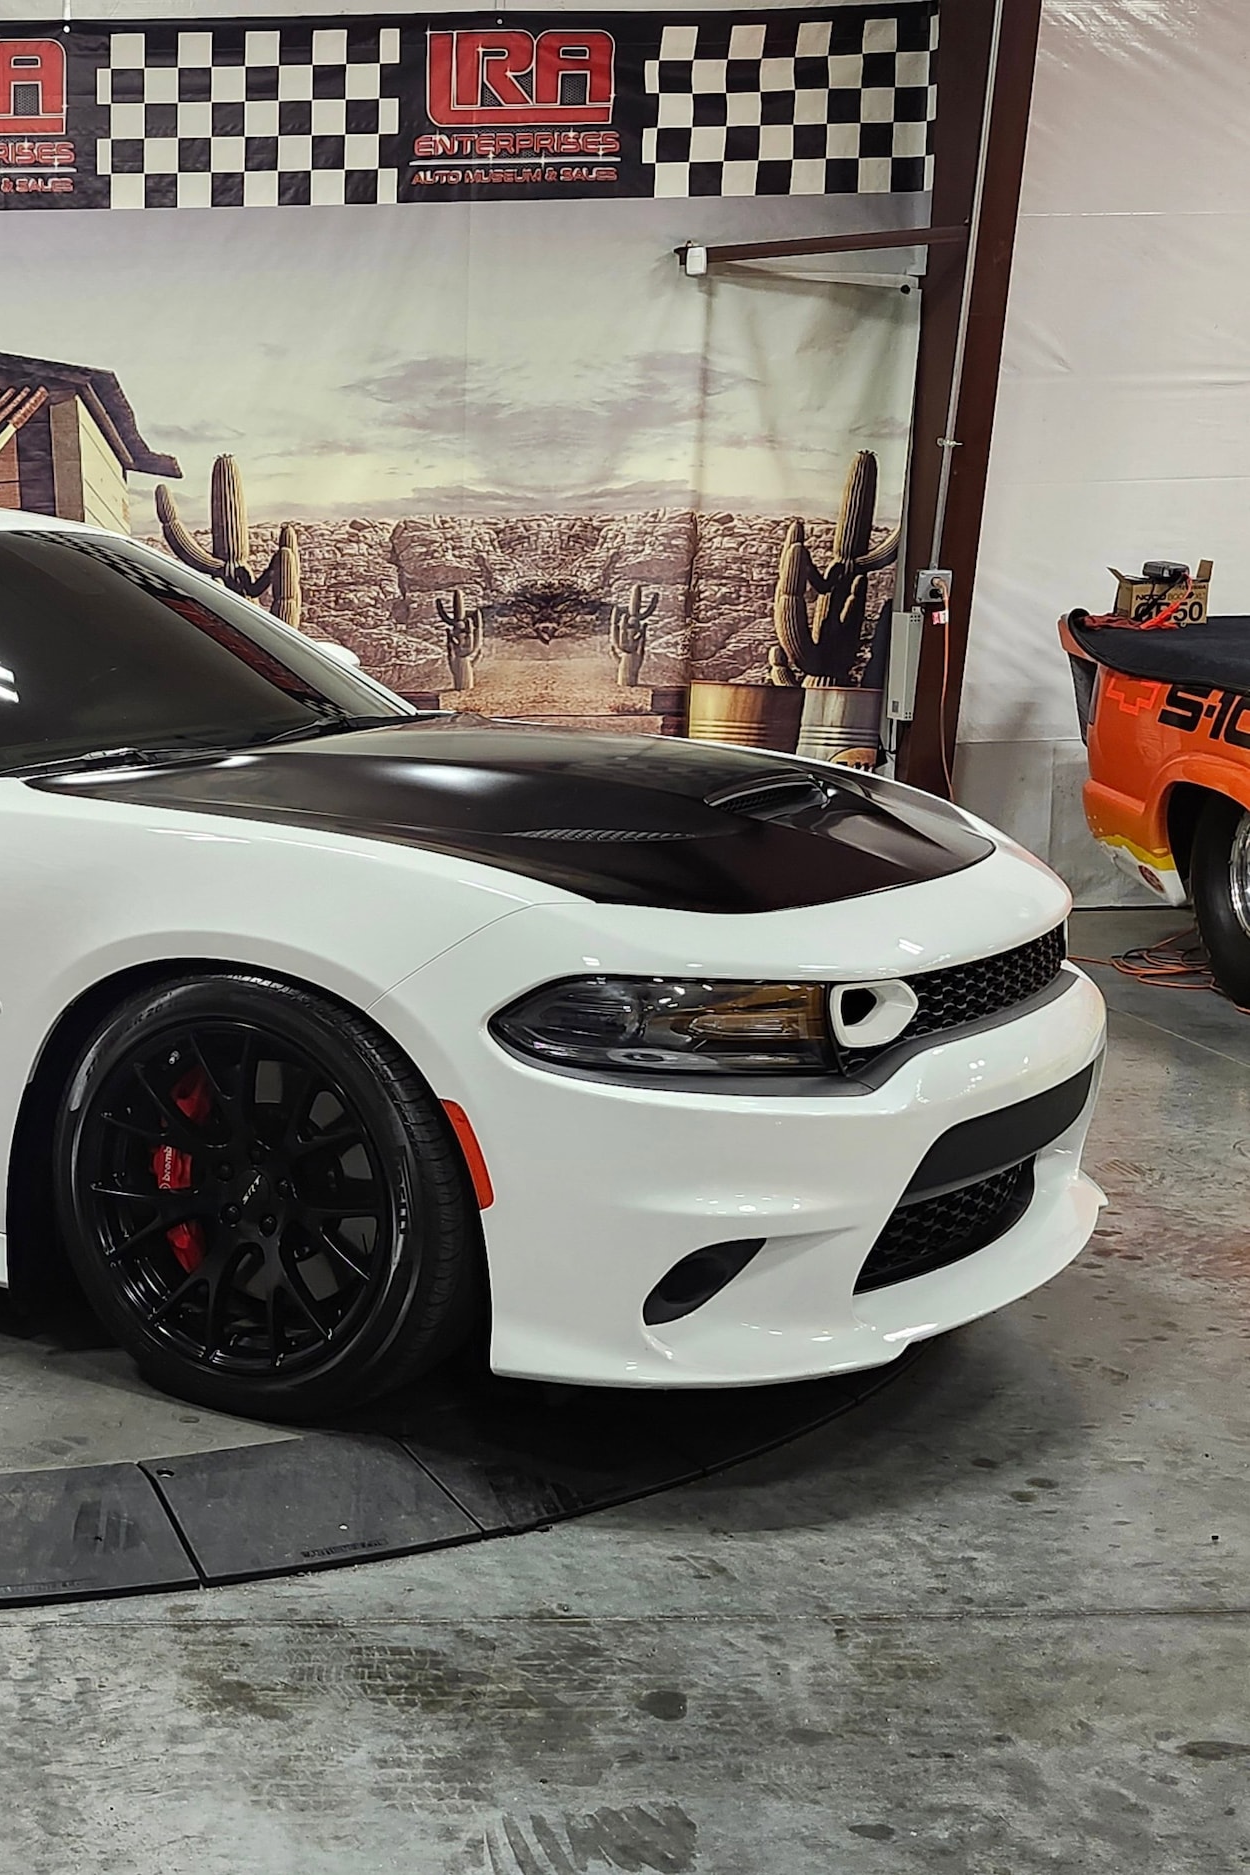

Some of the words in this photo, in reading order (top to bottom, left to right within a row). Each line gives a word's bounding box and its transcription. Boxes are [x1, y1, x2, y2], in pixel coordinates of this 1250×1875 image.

[426, 29, 615, 127] LRA
[414, 131, 620, 156] ENTERPRISES
[1, 179, 14, 193] &
[15, 177, 74, 193] SALES
[411, 169, 462, 185] AUTO
[464, 169, 542, 184] MUSEUM
[545, 168, 557, 182] &
[560, 167, 618, 182] SALES
